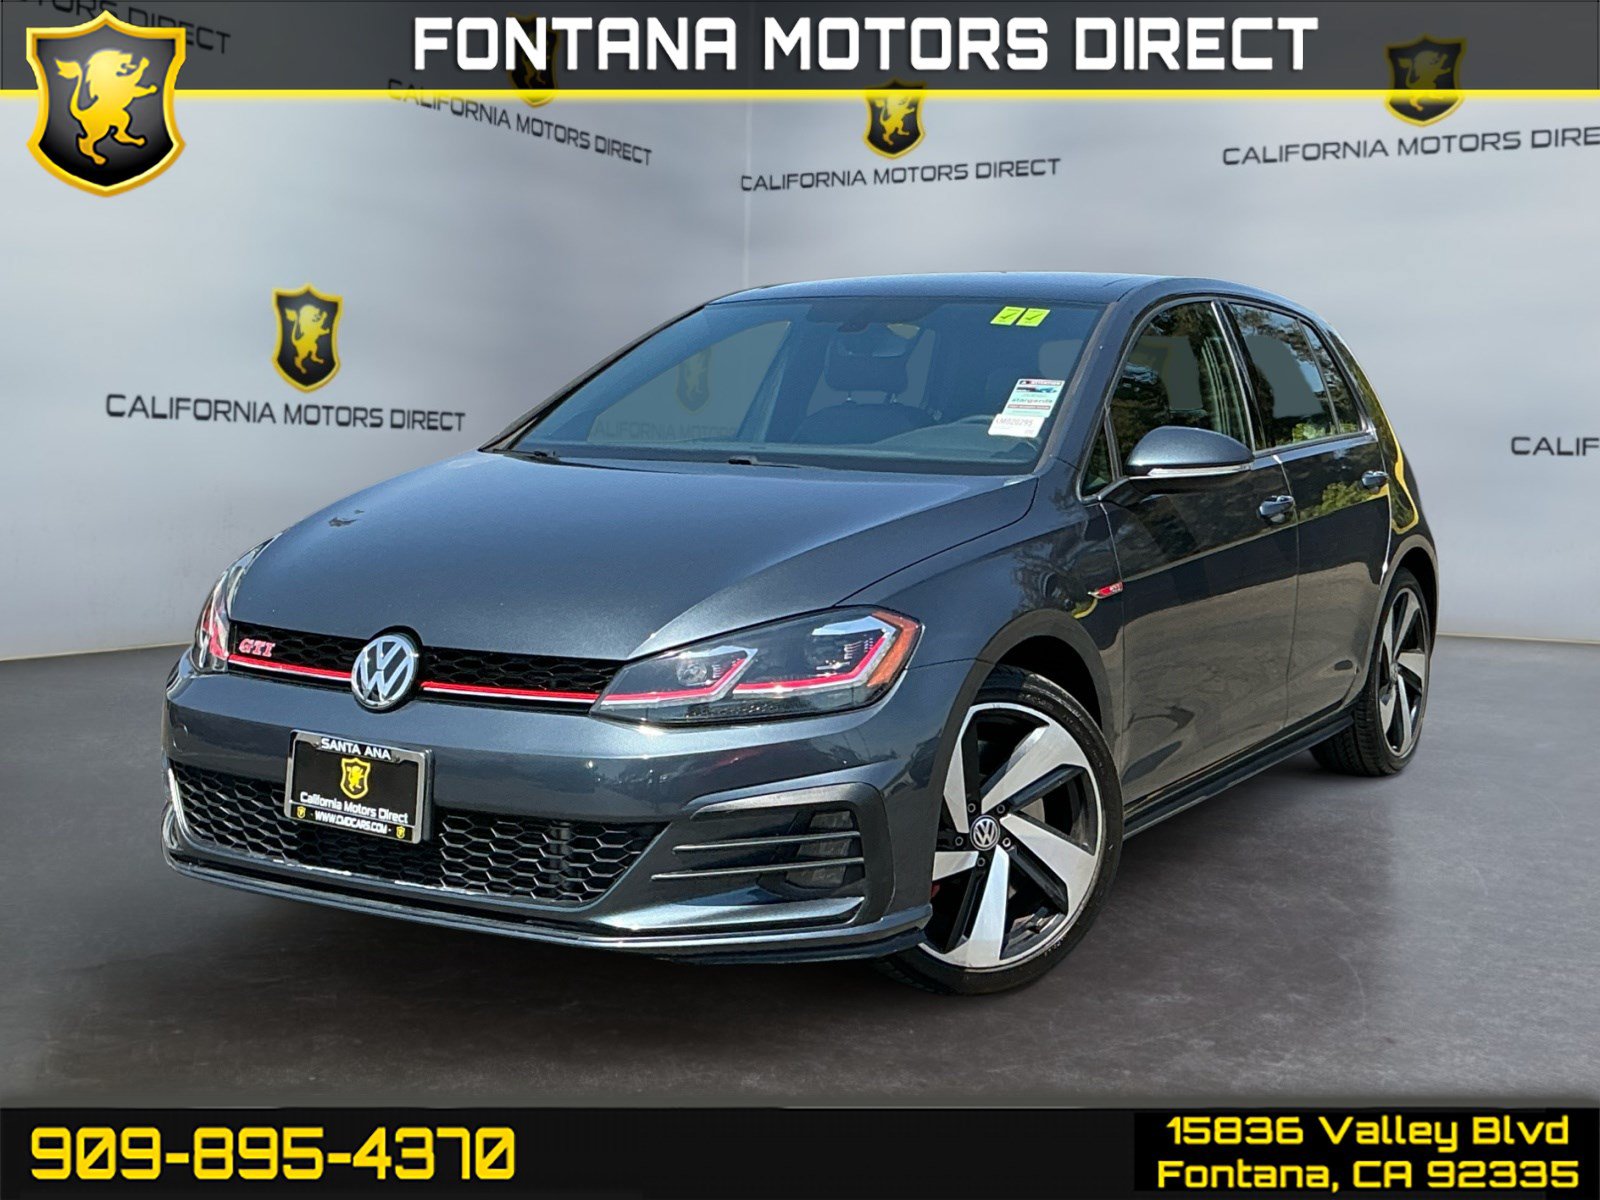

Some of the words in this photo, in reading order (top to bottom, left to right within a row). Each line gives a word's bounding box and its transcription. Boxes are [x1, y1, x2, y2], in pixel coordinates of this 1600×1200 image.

[387, 78, 512, 130] CALIFORNIA
[516, 113, 591, 150] MOTORS
[594, 135, 653, 166] DIRECT
[1223, 139, 1390, 166] CALIFORNIA
[1397, 131, 1522, 157] MOTORS
[741, 169, 868, 192] CALIFORNIA
[873, 163, 969, 186] MOTORS
[975, 158, 1062, 179] DIRECT
[105, 393, 277, 425] CALIFORNIA
[283, 403, 384, 429] MOTORS
[390, 408, 466, 432] DIRECT
[1510, 436, 1600, 457] CALIF
[238, 637, 276, 658] GTI
[320, 737, 361, 756] SANTA
[363, 746, 392, 761] ANA
[299, 791, 343, 812] California
[343, 800, 377, 818] Motors
[378, 806, 409, 824] Direct
